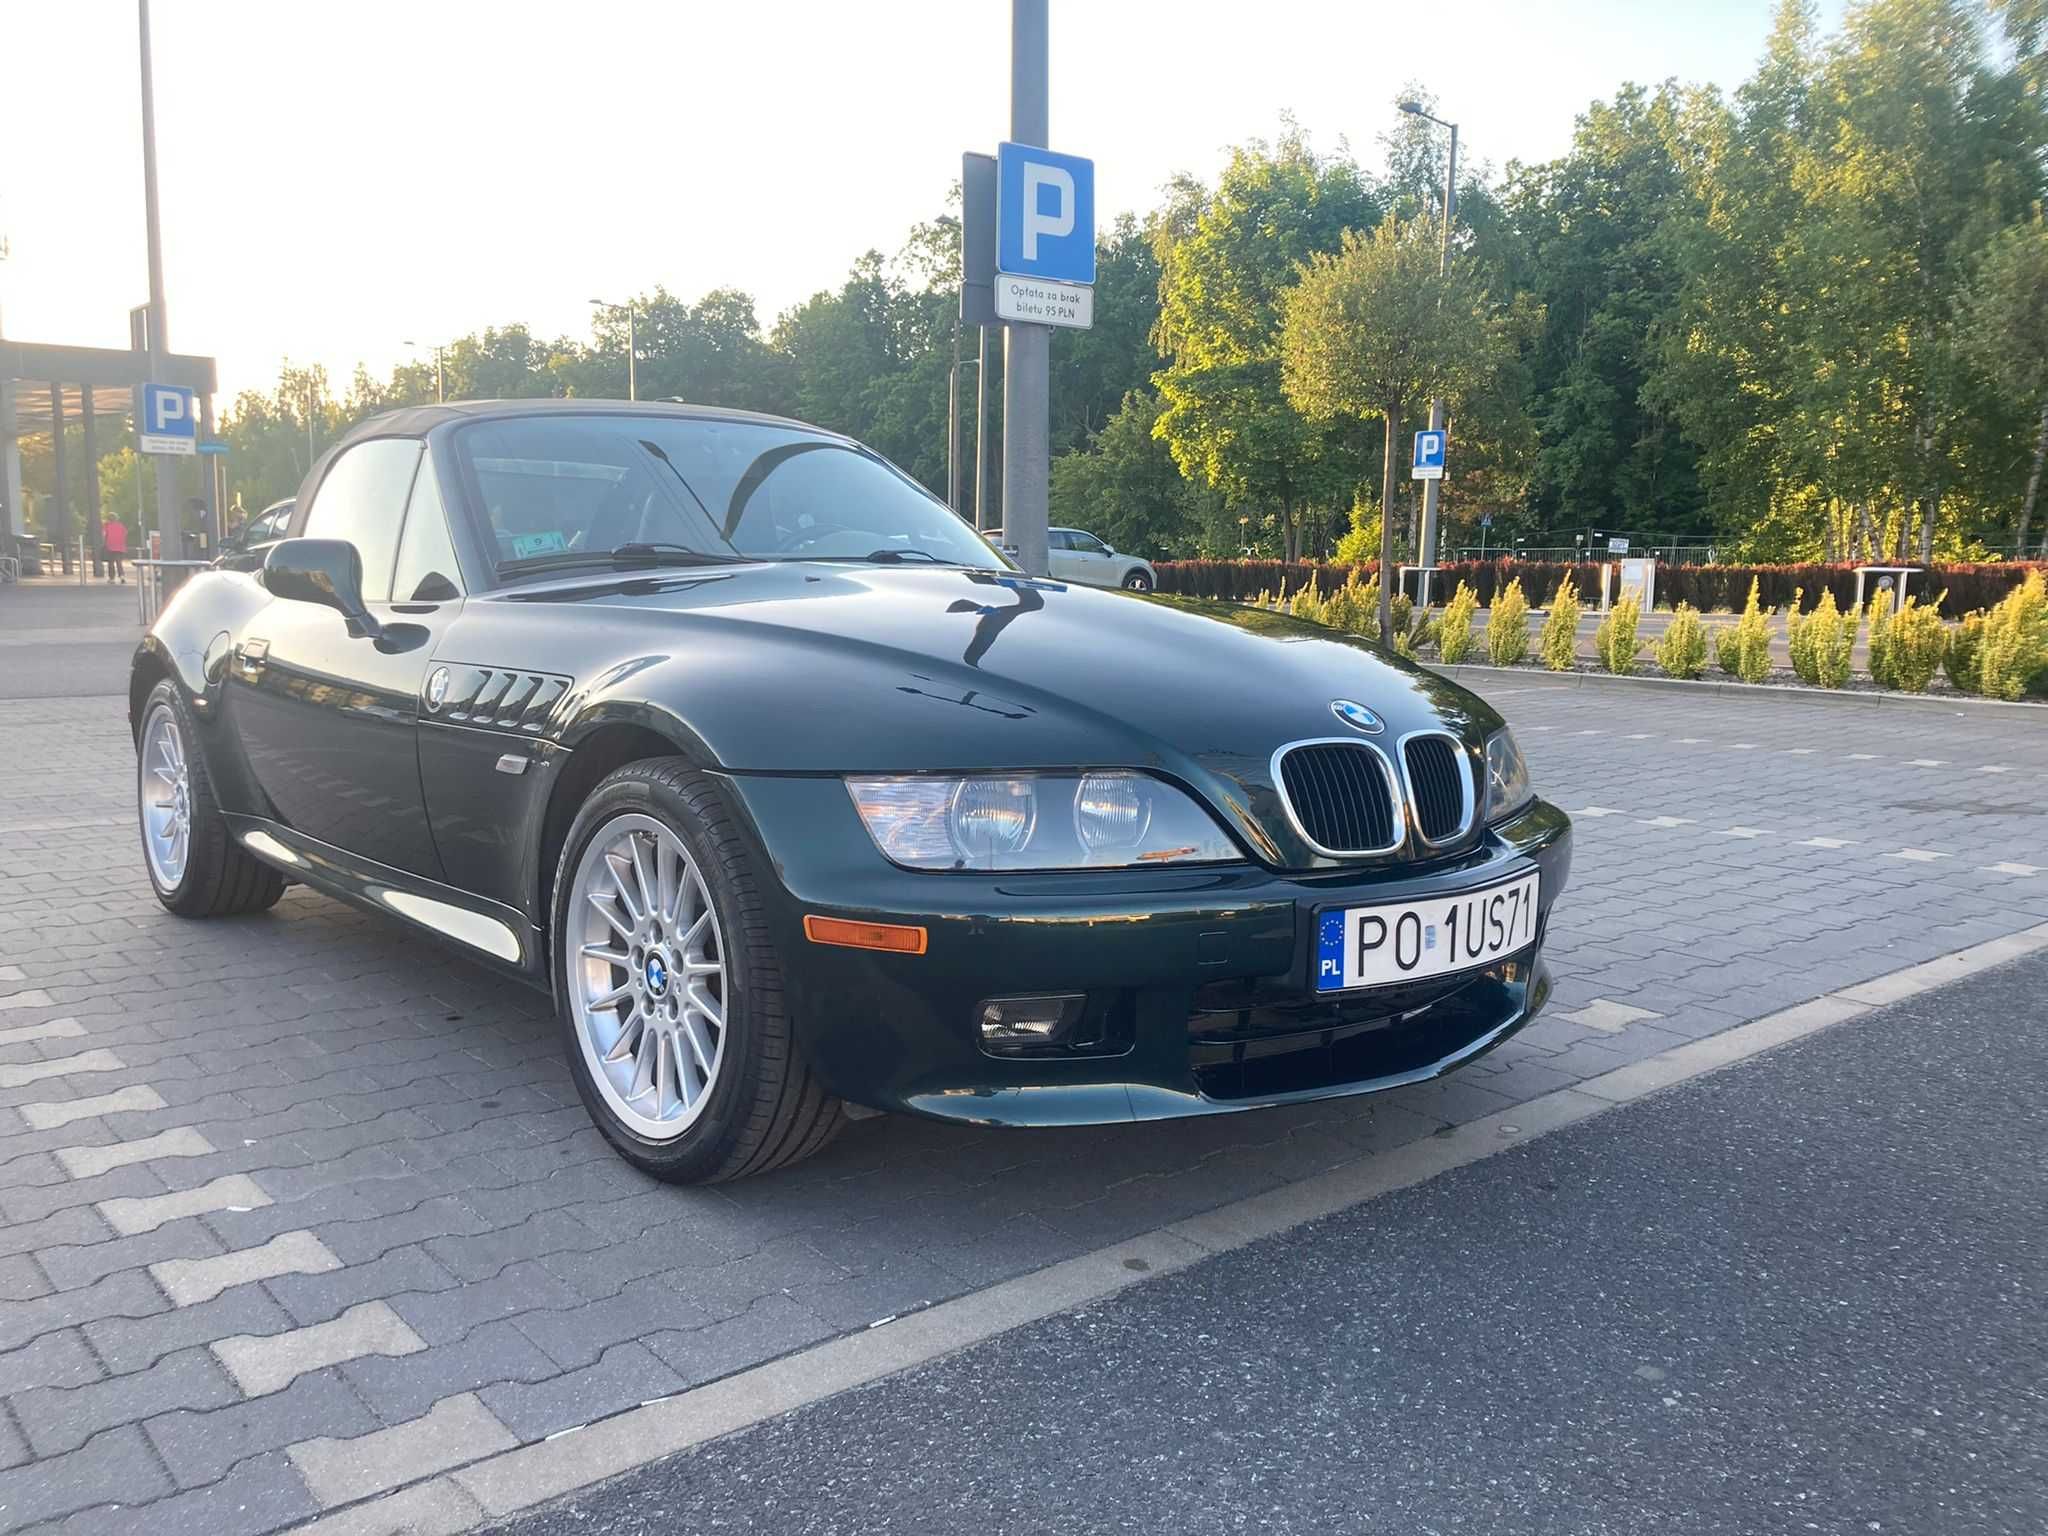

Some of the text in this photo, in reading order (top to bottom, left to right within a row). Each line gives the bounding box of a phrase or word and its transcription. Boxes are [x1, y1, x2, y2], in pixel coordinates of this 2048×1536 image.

[1022, 161, 1075, 261] P
[1010, 284, 1081, 304] Opłata za brak
[1016, 301, 1075, 319] biletu 95 PLN
[156, 390, 184, 430] P
[1421, 434, 1440, 465] P
[1357, 883, 1531, 977] PO 1US71
[1321, 959, 1341, 977] PL
